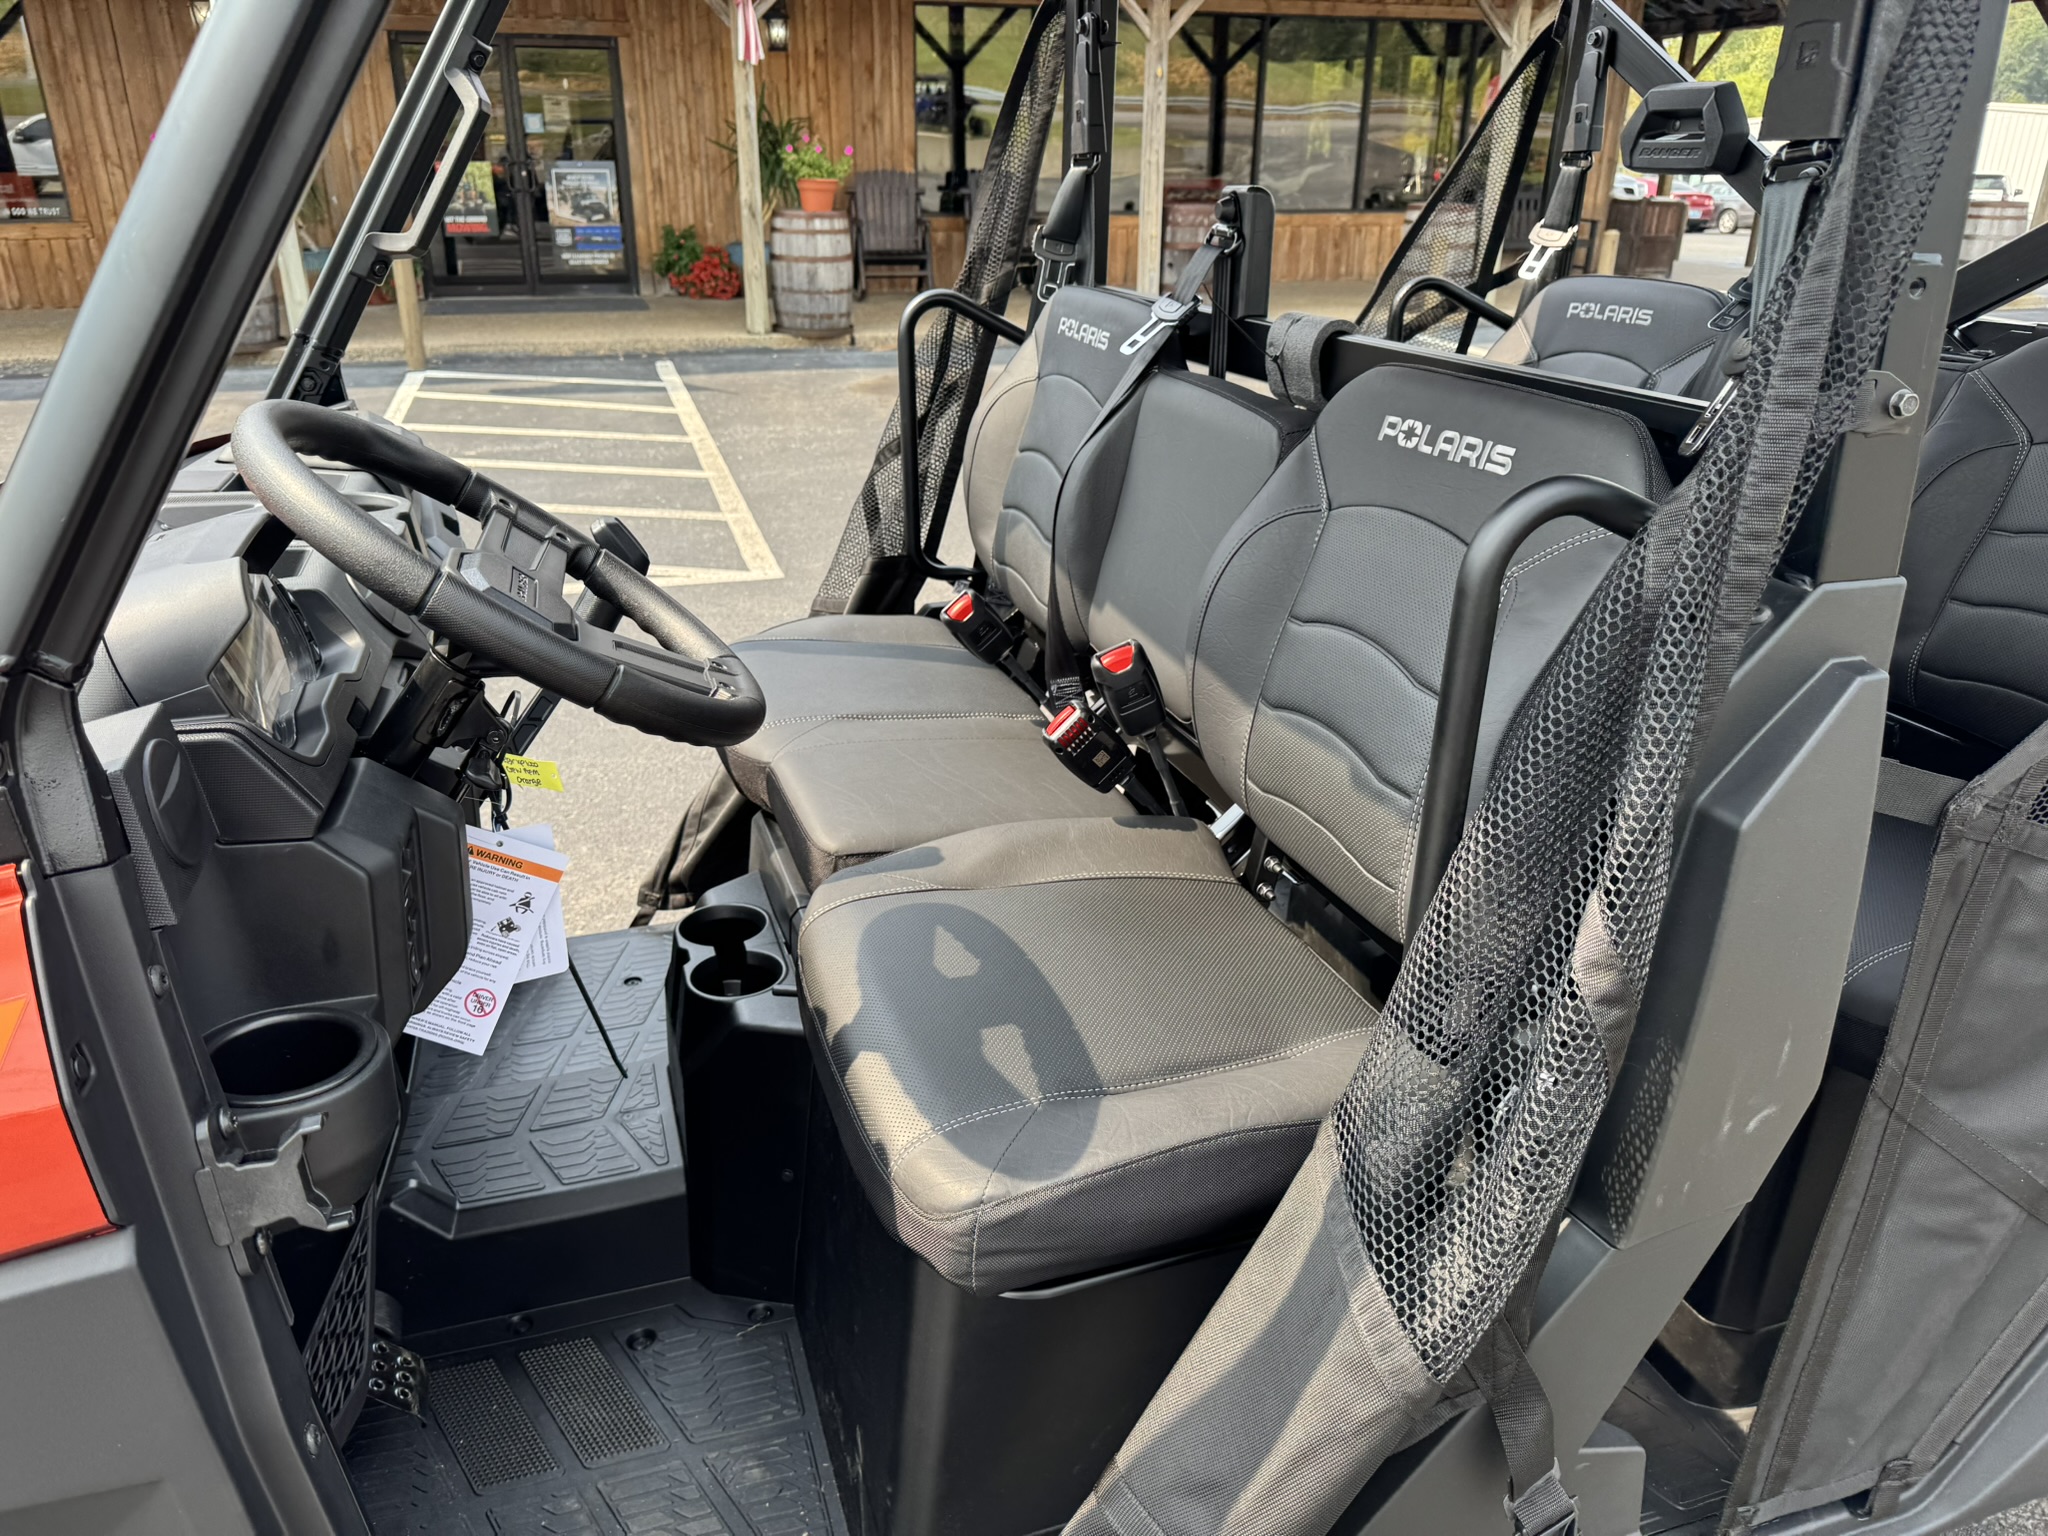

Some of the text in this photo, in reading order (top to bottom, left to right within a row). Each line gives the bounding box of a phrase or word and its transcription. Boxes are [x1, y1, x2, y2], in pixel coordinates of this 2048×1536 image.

[1639, 147, 1702, 159] RANGER
[39, 207, 60, 216] TRUST
[1566, 302, 1654, 326] POLARIS
[1057, 317, 1111, 351] POLARIS
[1377, 415, 1517, 476] POLARIS
[476, 848, 524, 869] WARNING
[473, 860, 490, 869] Vehicle
[510, 871, 526, 879] Result
[477, 867, 496, 876] INJURY
[502, 874, 519, 882] DEATH
[487, 957, 502, 965] Ahead
[471, 998, 491, 1008] UNDER
[473, 992, 493, 1003] DRIVER
[473, 1004, 484, 1014] 16
